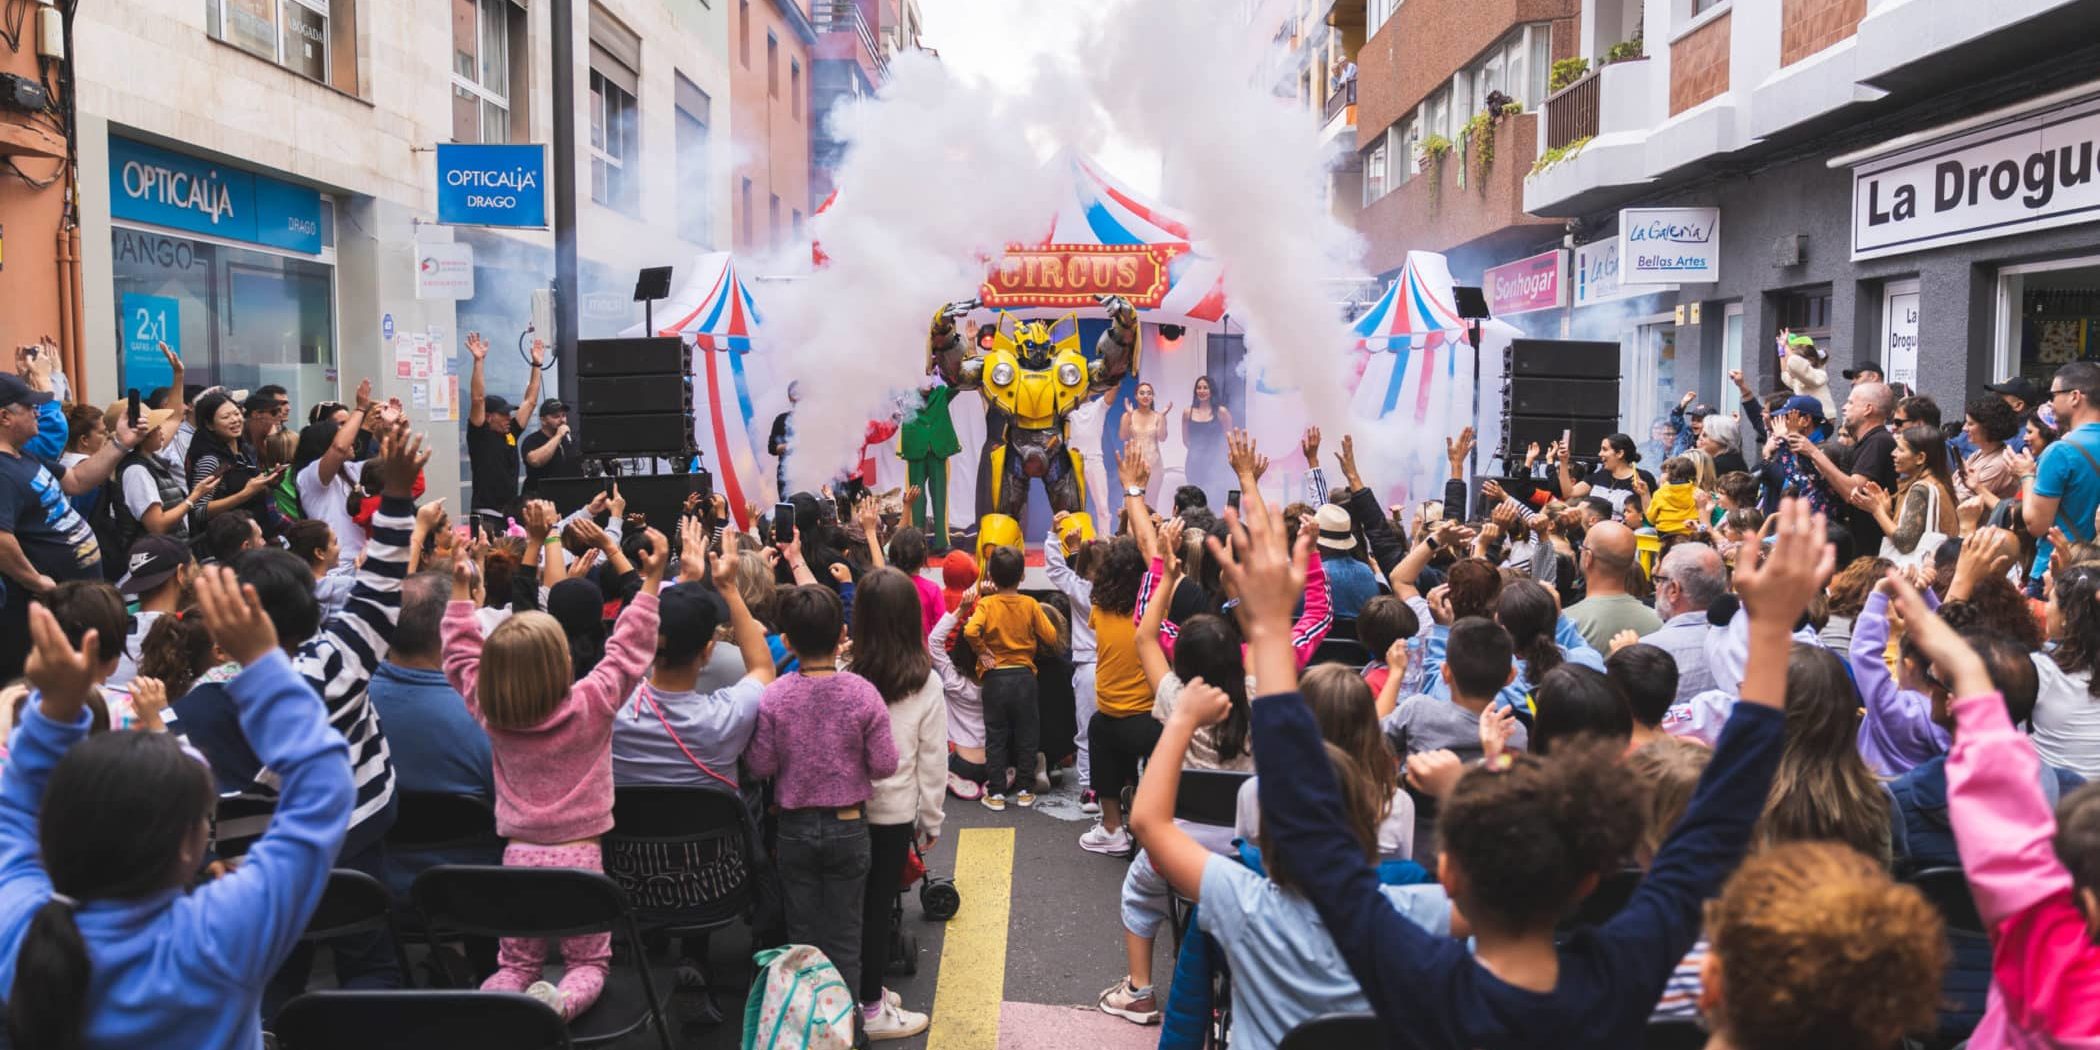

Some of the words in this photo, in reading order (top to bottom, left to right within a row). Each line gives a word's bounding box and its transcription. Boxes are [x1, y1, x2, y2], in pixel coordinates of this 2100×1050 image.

[1868, 180, 1917, 227] La
[1934, 140, 2100, 214] Drogu
[467, 195, 516, 209] DRAGO
[287, 216, 317, 236] DRAGO
[1630, 224, 1646, 241] La
[111, 231, 194, 271] ANGO
[1637, 255, 1672, 267] Bellas
[1675, 256, 1707, 267] Artes
[1000, 255, 1139, 289] CIRCUS
[1495, 271, 1555, 301] Sonhogar
[136, 307, 167, 341] 2x1
[1906, 307, 1917, 324] La
[1892, 332, 1918, 352] Drogu
